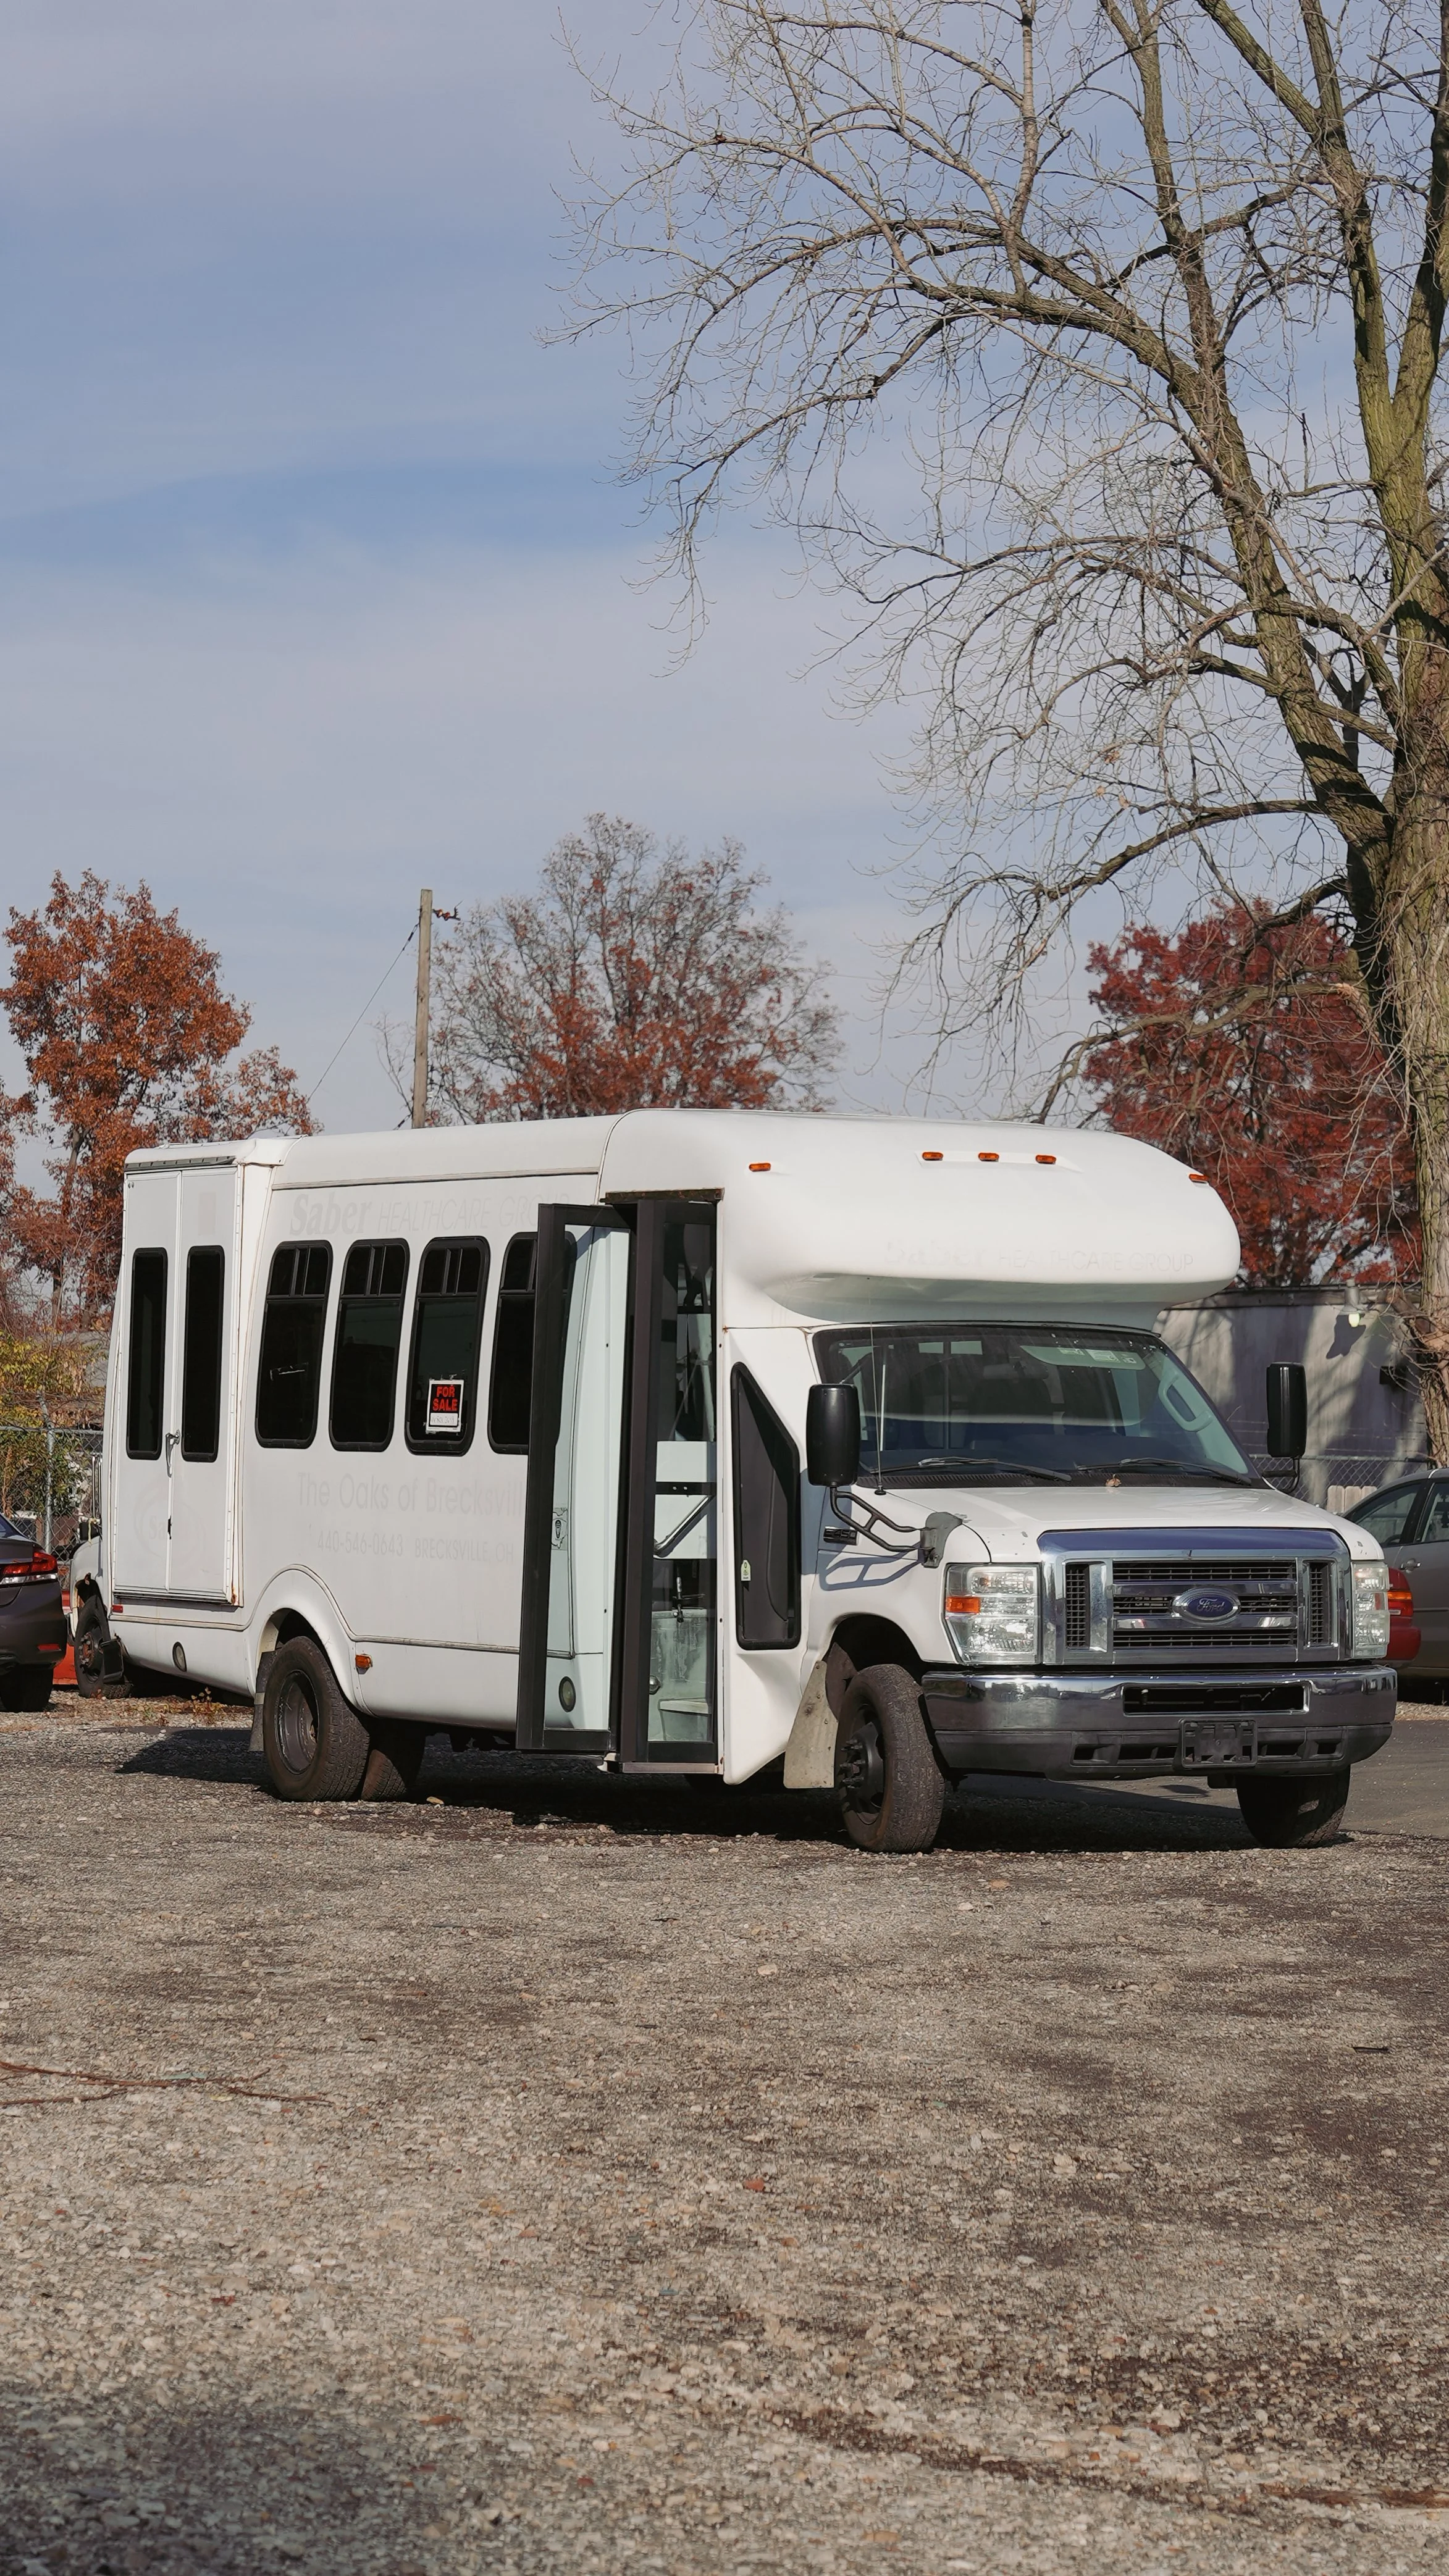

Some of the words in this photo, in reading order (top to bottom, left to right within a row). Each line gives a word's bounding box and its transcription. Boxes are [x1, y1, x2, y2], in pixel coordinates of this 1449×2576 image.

[290, 1192, 372, 1235] Saber
[378, 1198, 491, 1233] HEALTHCARE
[1130, 1252, 1193, 1272] GROUP
[436, 1385, 455, 1397] FOR
[432, 1399, 458, 1411] SALE
[298, 1471, 330, 1507] The
[339, 1473, 389, 1510] Oaks
[397, 1476, 418, 1512] of
[426, 1477, 524, 1517] Brecksvill
[317, 1529, 403, 1557] 440-546-0643
[495, 1542, 514, 1565] OH
[1196, 1598, 1225, 1612] Ford
